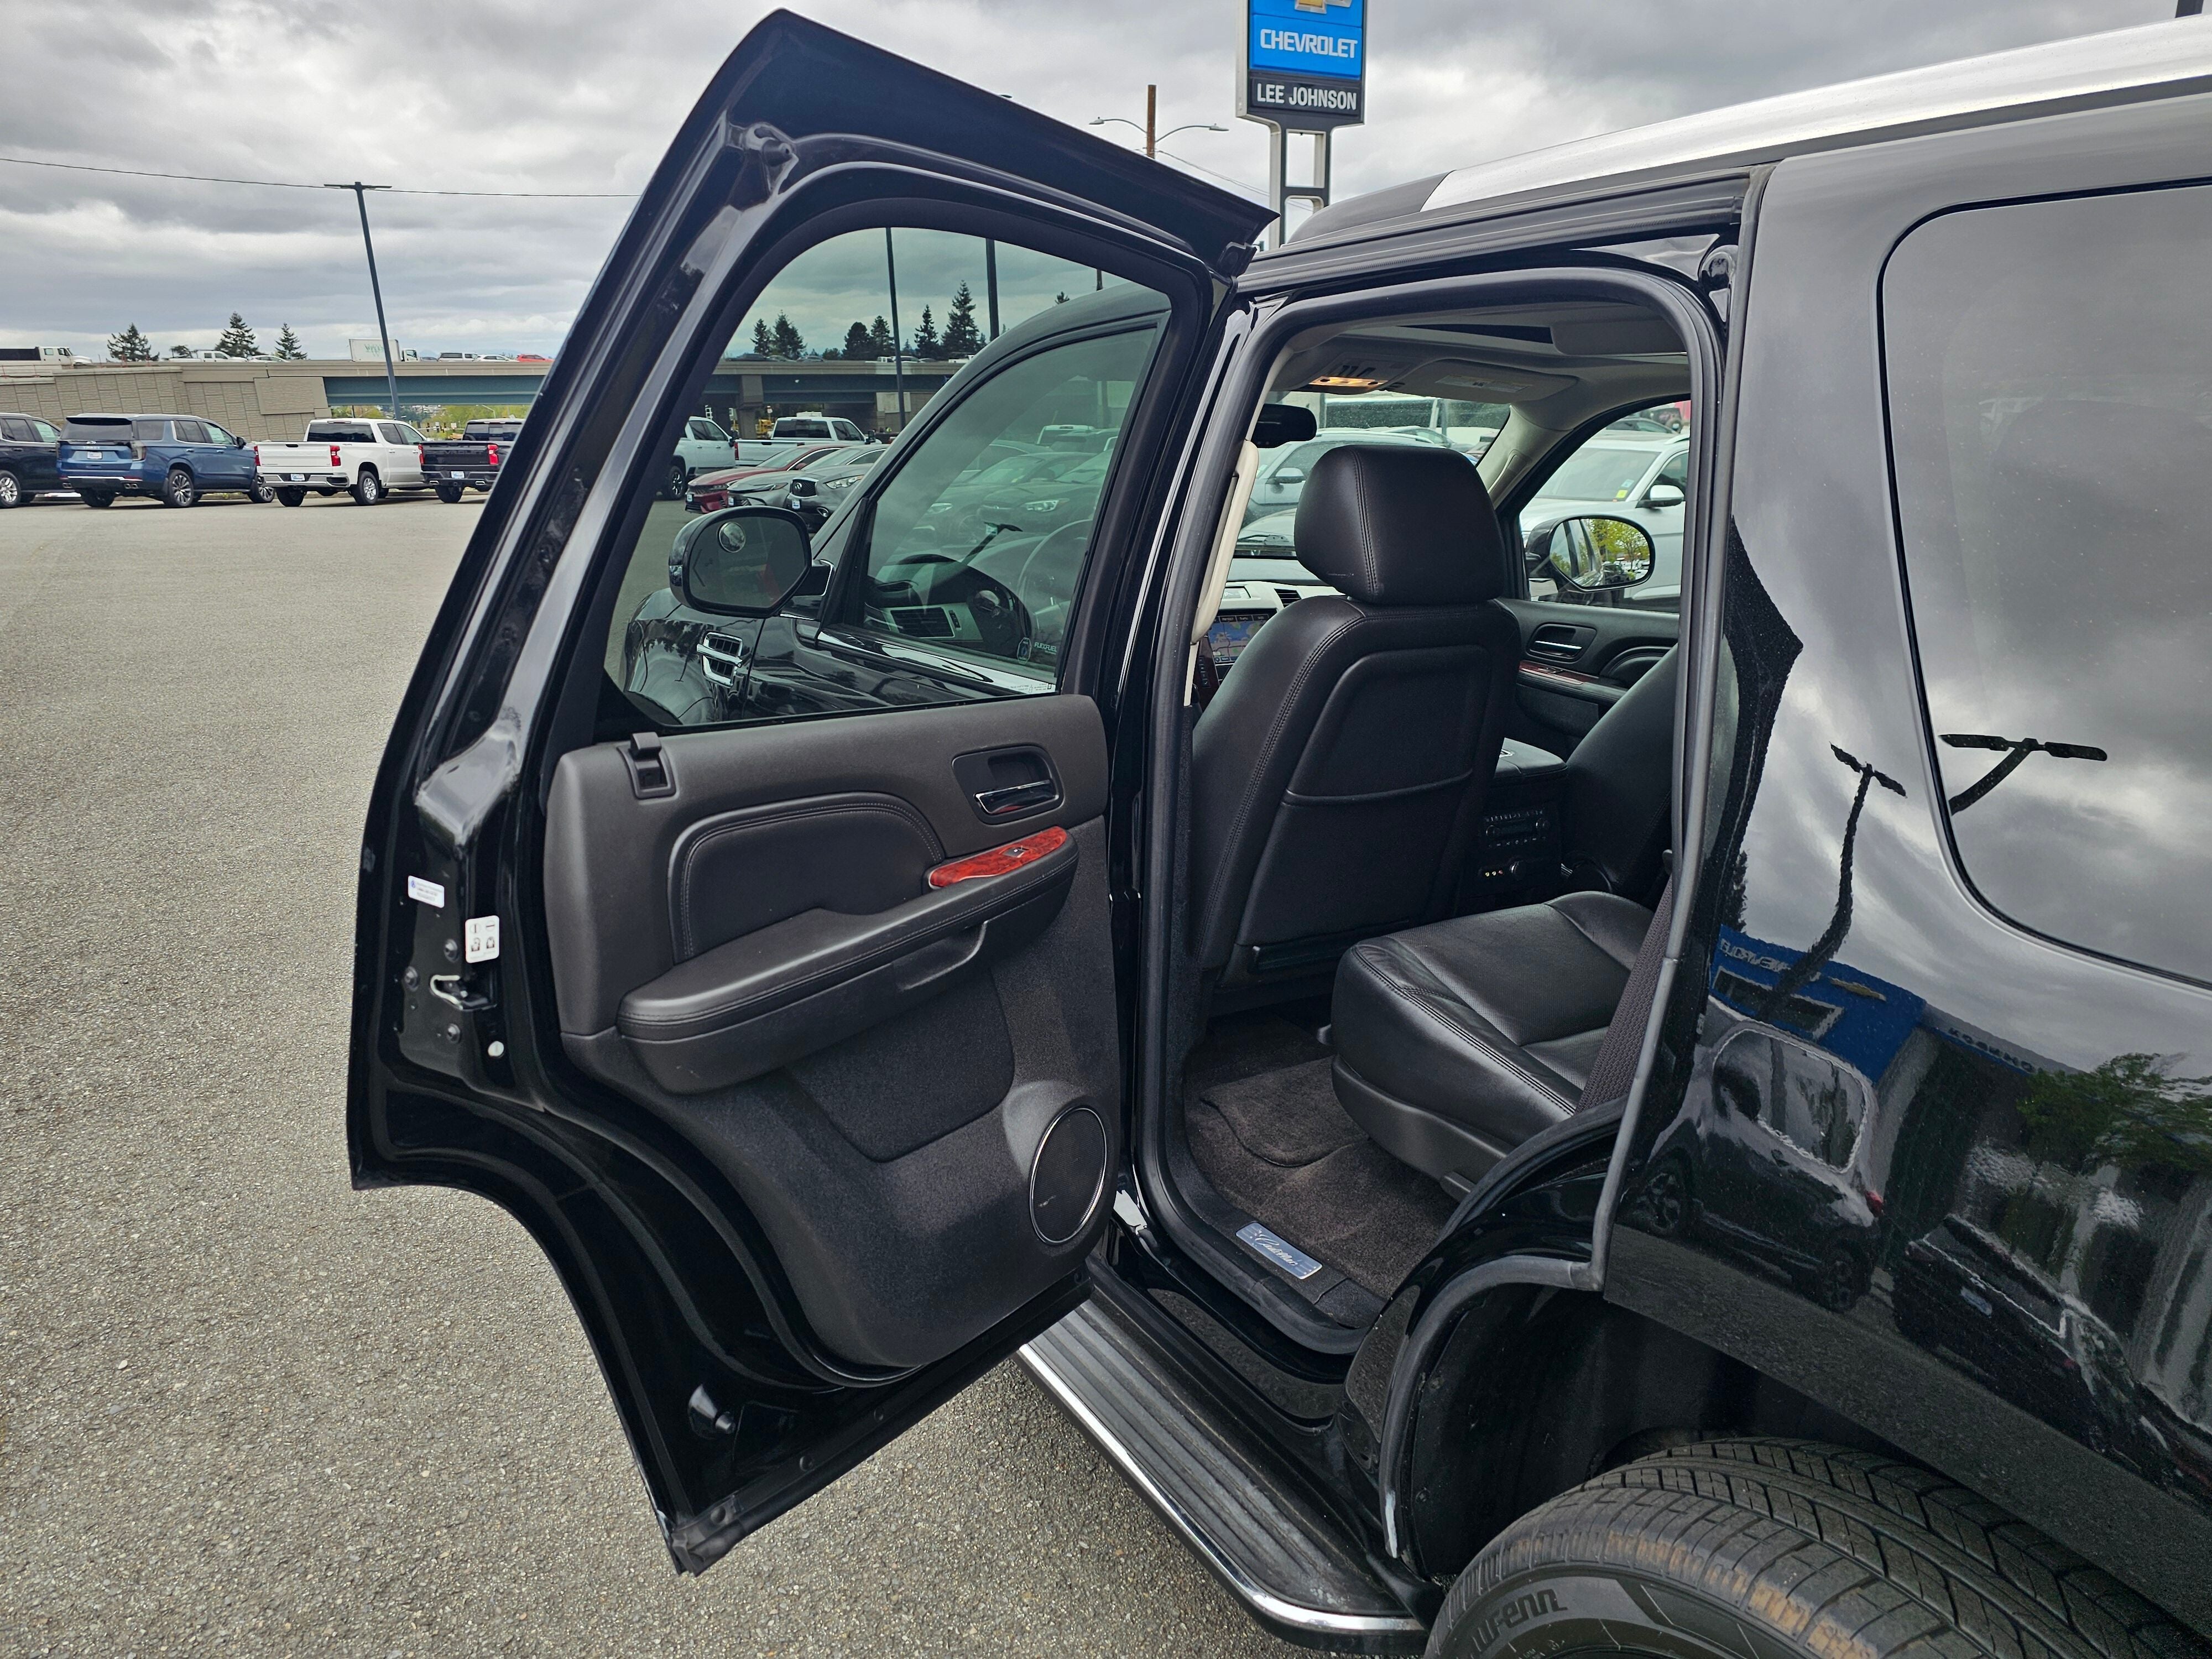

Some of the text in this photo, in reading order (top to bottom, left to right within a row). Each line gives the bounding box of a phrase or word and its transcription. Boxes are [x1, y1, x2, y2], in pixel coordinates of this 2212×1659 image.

[1260, 29, 1358, 58] CHEVROLET
[1257, 84, 1357, 110] LEE JOHNSON
[1034, 641, 1057, 653] FLEXFUEL
[1254, 1234, 1298, 1266] Cadillac
